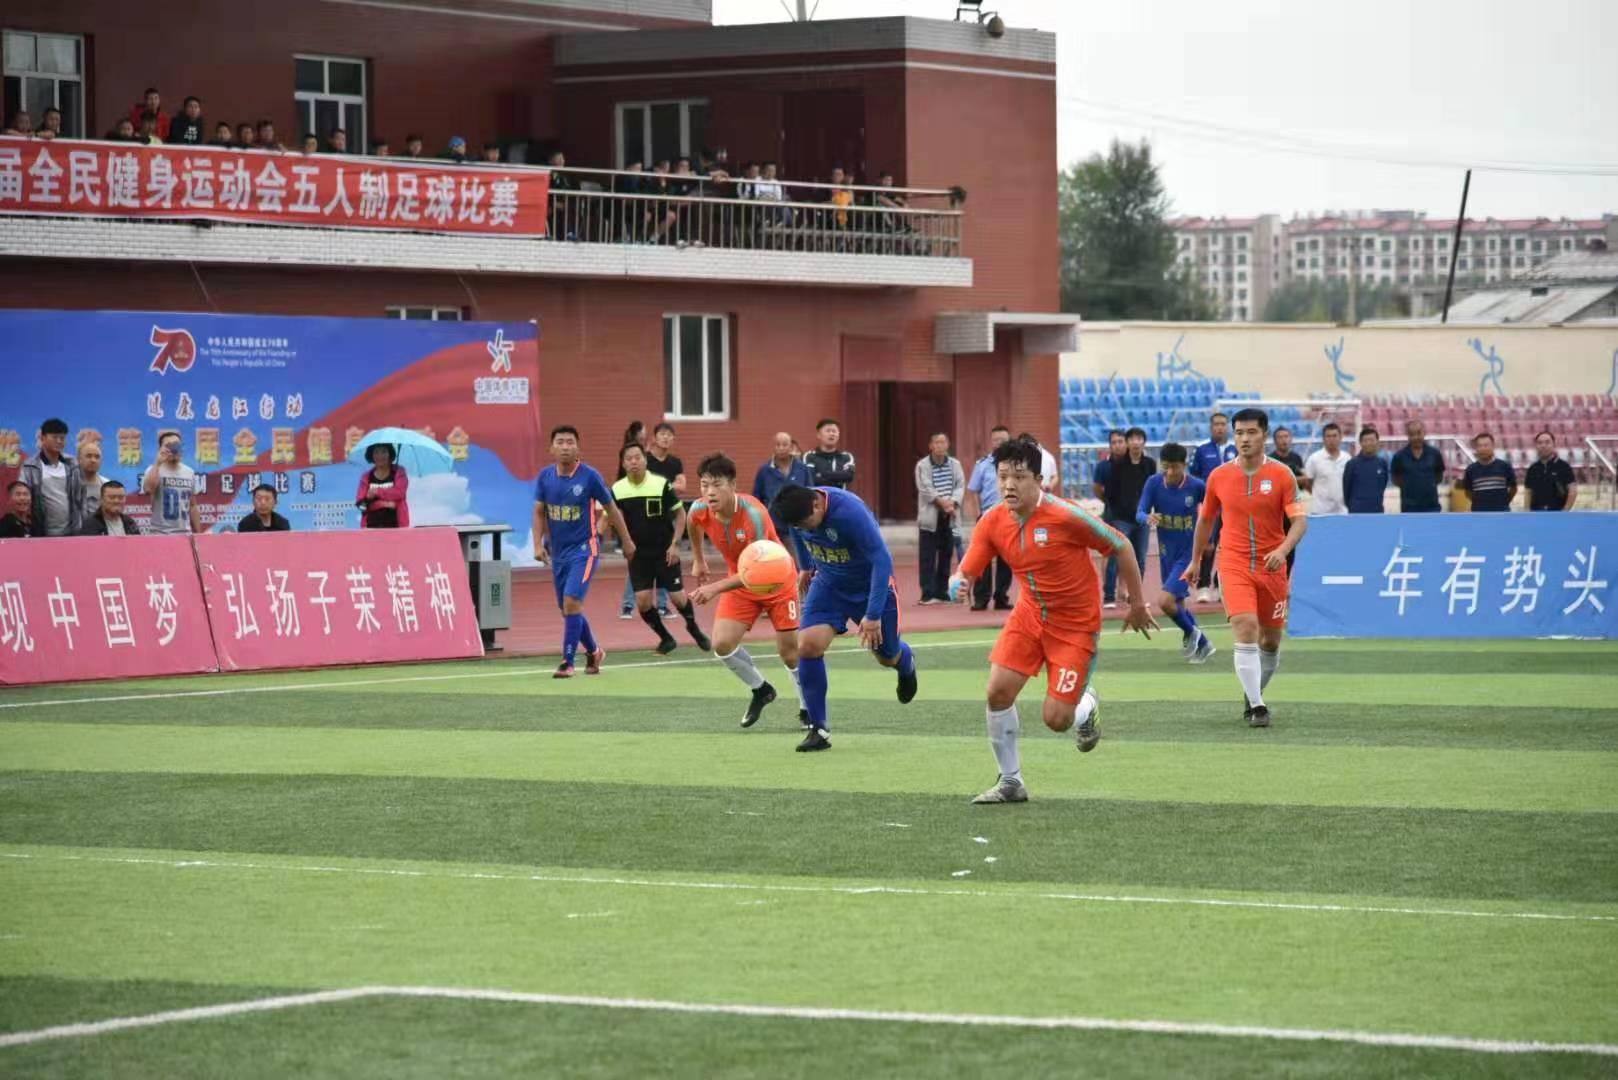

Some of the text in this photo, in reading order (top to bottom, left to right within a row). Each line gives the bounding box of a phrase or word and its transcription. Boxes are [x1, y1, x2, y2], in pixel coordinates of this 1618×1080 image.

[0, 147, 519, 227] 届全民健身运动会五人制足球比赛
[0, 575, 179, 652] 现中国梦
[222, 562, 457, 640] 弘扬子荣精神
[788, 600, 797, 620] 9
[1321, 545, 1608, 616] 一年有势头
[1056, 667, 1078, 693] 13
